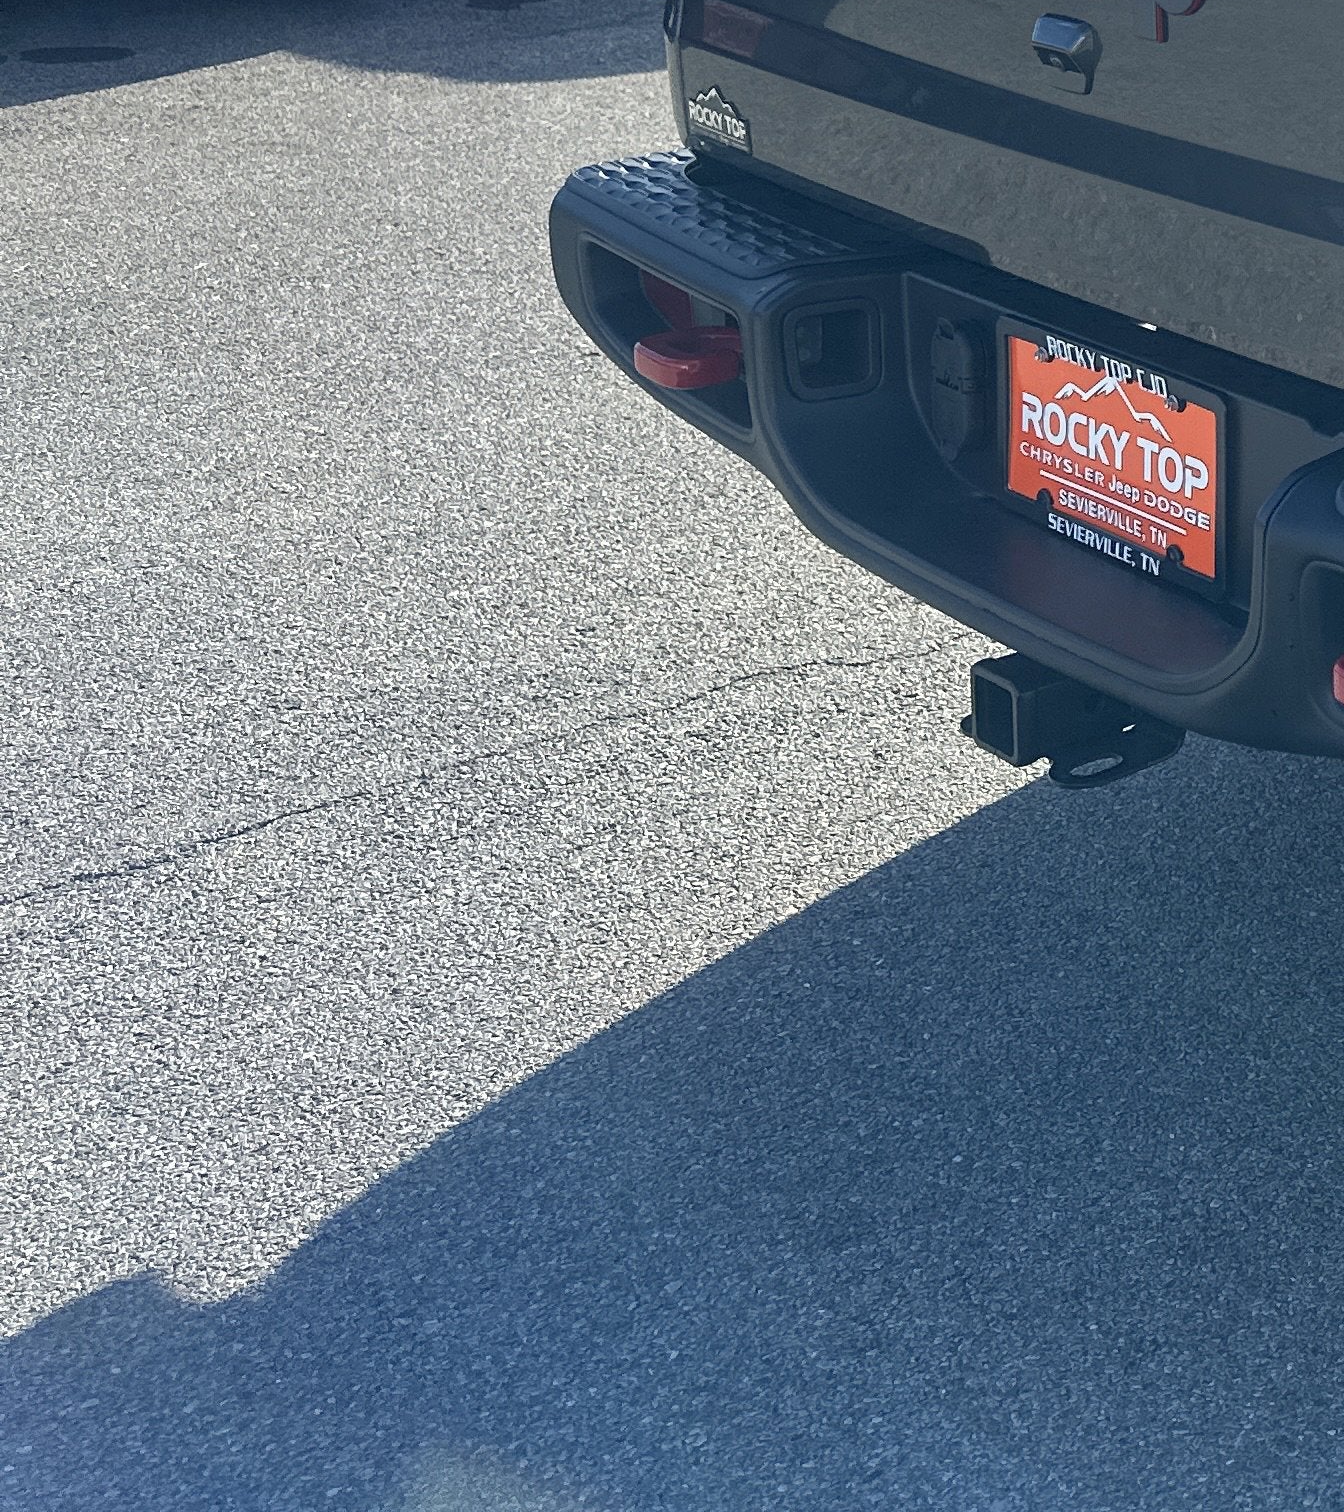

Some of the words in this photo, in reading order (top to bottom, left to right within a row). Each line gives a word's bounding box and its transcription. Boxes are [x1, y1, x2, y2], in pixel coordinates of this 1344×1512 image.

[688, 100, 723, 131] ROCKY
[724, 114, 746, 140] TOP
[1046, 335, 1098, 372] ROCKY
[1100, 355, 1132, 384] TOP
[1137, 368, 1168, 399] CJD
[1021, 391, 1131, 471] ROCKY
[1136, 436, 1209, 499] TOP
[1019, 441, 1105, 487] CHRYSLER
[1108, 473, 1141, 504] Jeep
[1143, 490, 1211, 531] DODGE
[1047, 512, 1136, 568] SEVIERVILLE,
[1140, 552, 1160, 576] TN
[1058, 488, 1147, 542] SEVIERVILLE,
[1149, 525, 1167, 549] TN
